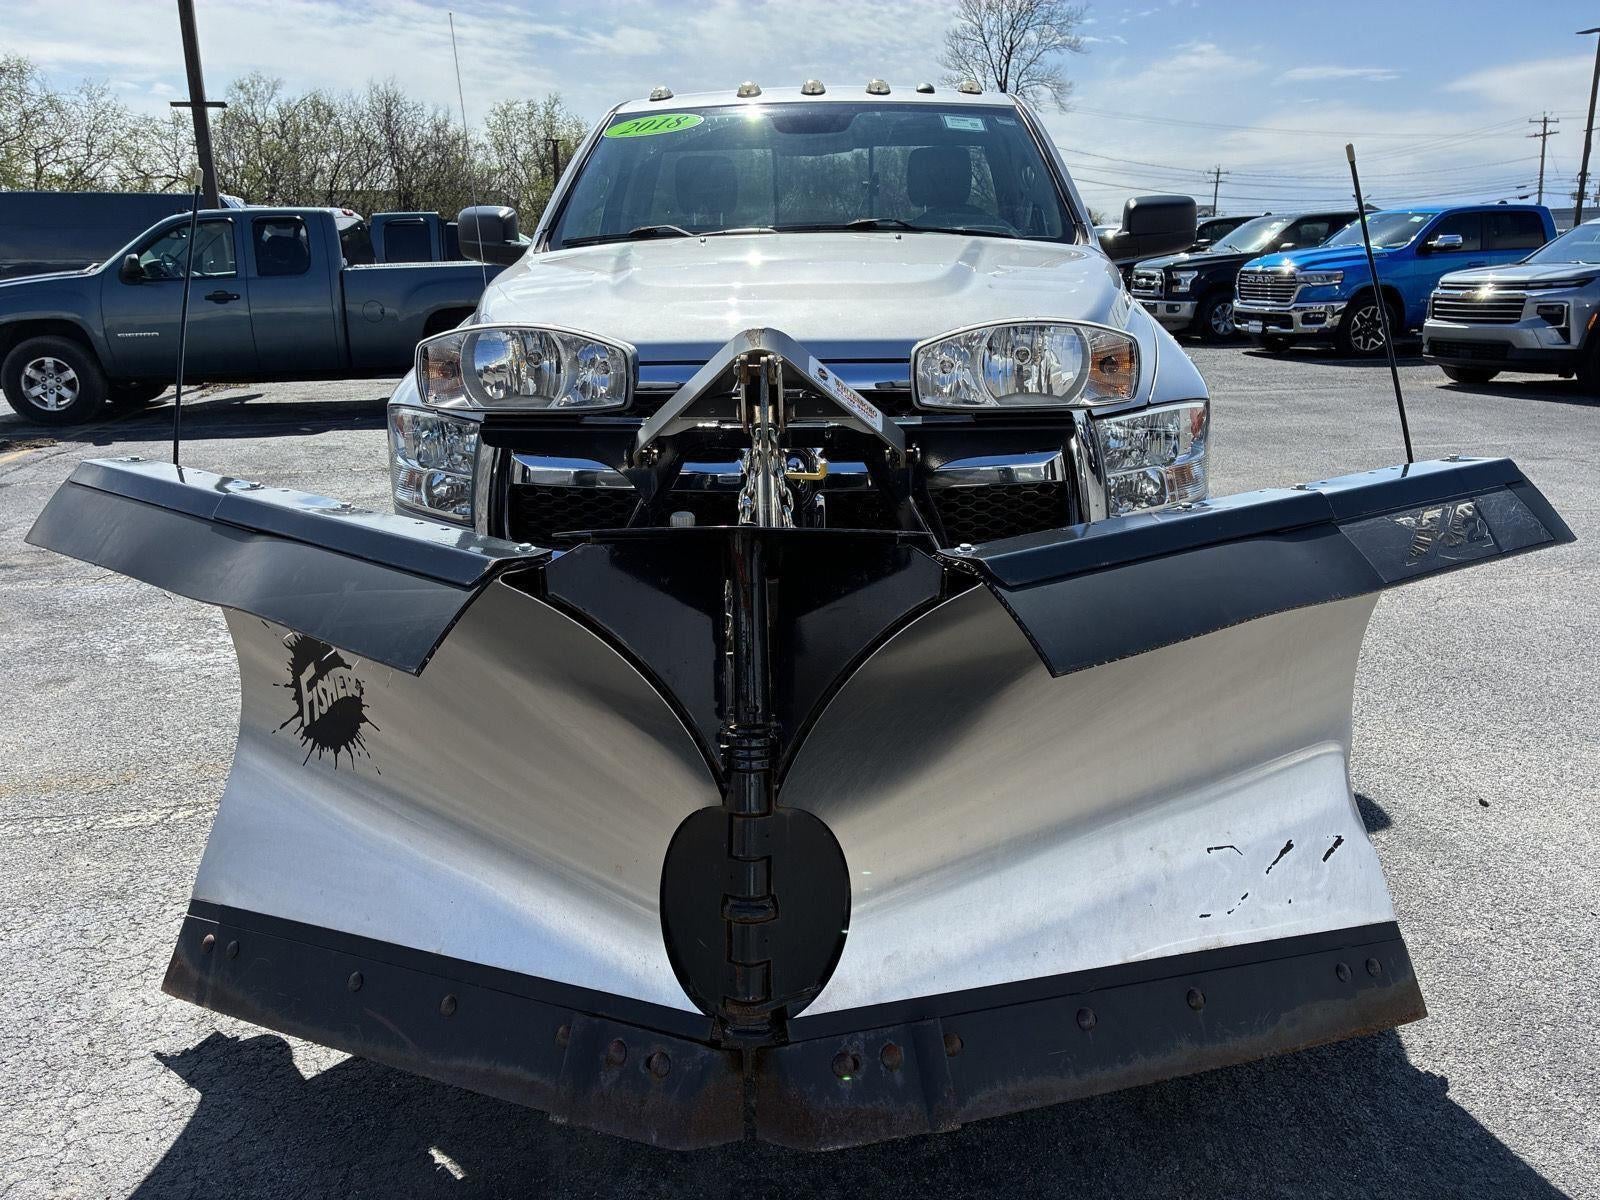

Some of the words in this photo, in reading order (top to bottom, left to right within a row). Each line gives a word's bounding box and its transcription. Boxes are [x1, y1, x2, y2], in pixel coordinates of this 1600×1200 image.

[617, 116, 689, 135] 2018
[1247, 275, 1275, 283] RAM
[300, 661, 361, 728] FISHER
